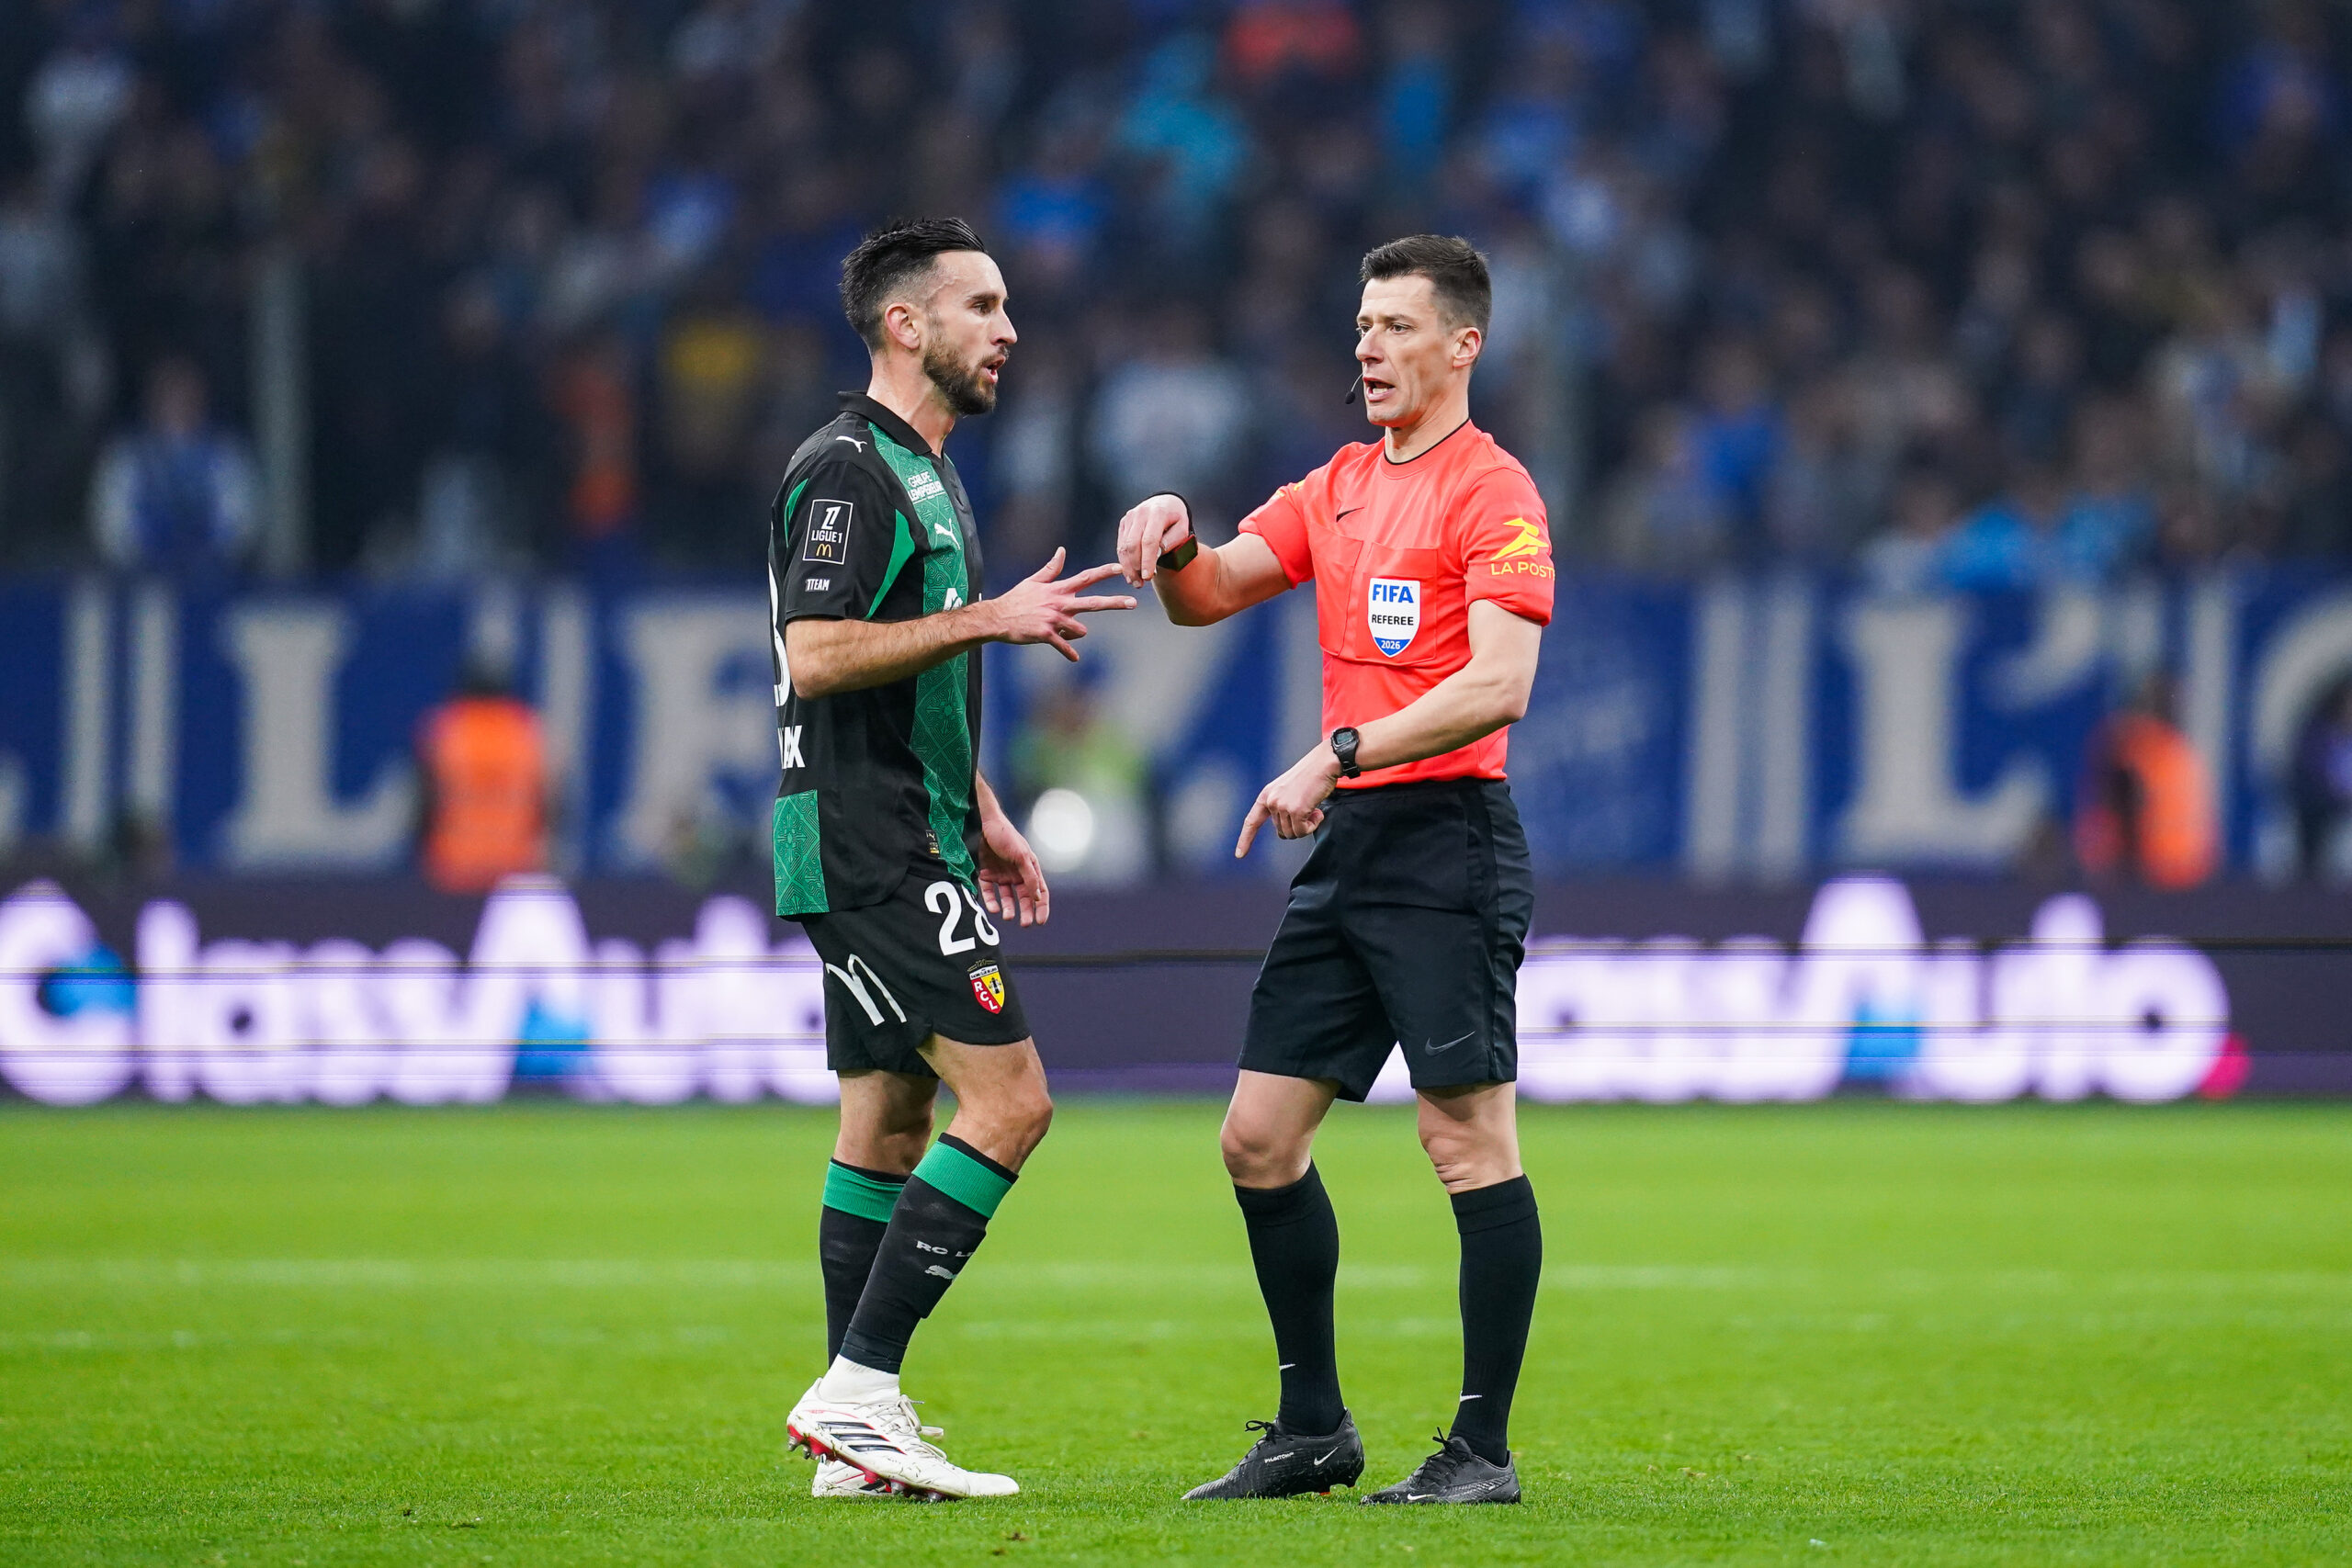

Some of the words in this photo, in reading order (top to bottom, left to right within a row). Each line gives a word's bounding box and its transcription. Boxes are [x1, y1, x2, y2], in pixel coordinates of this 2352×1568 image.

[811, 530, 837, 543] LIGUE
[1491, 561, 1514, 576] LA
[1373, 583, 1414, 604] FIFA
[1372, 615, 1414, 626] REFEREE
[1381, 640, 1401, 649] 2026
